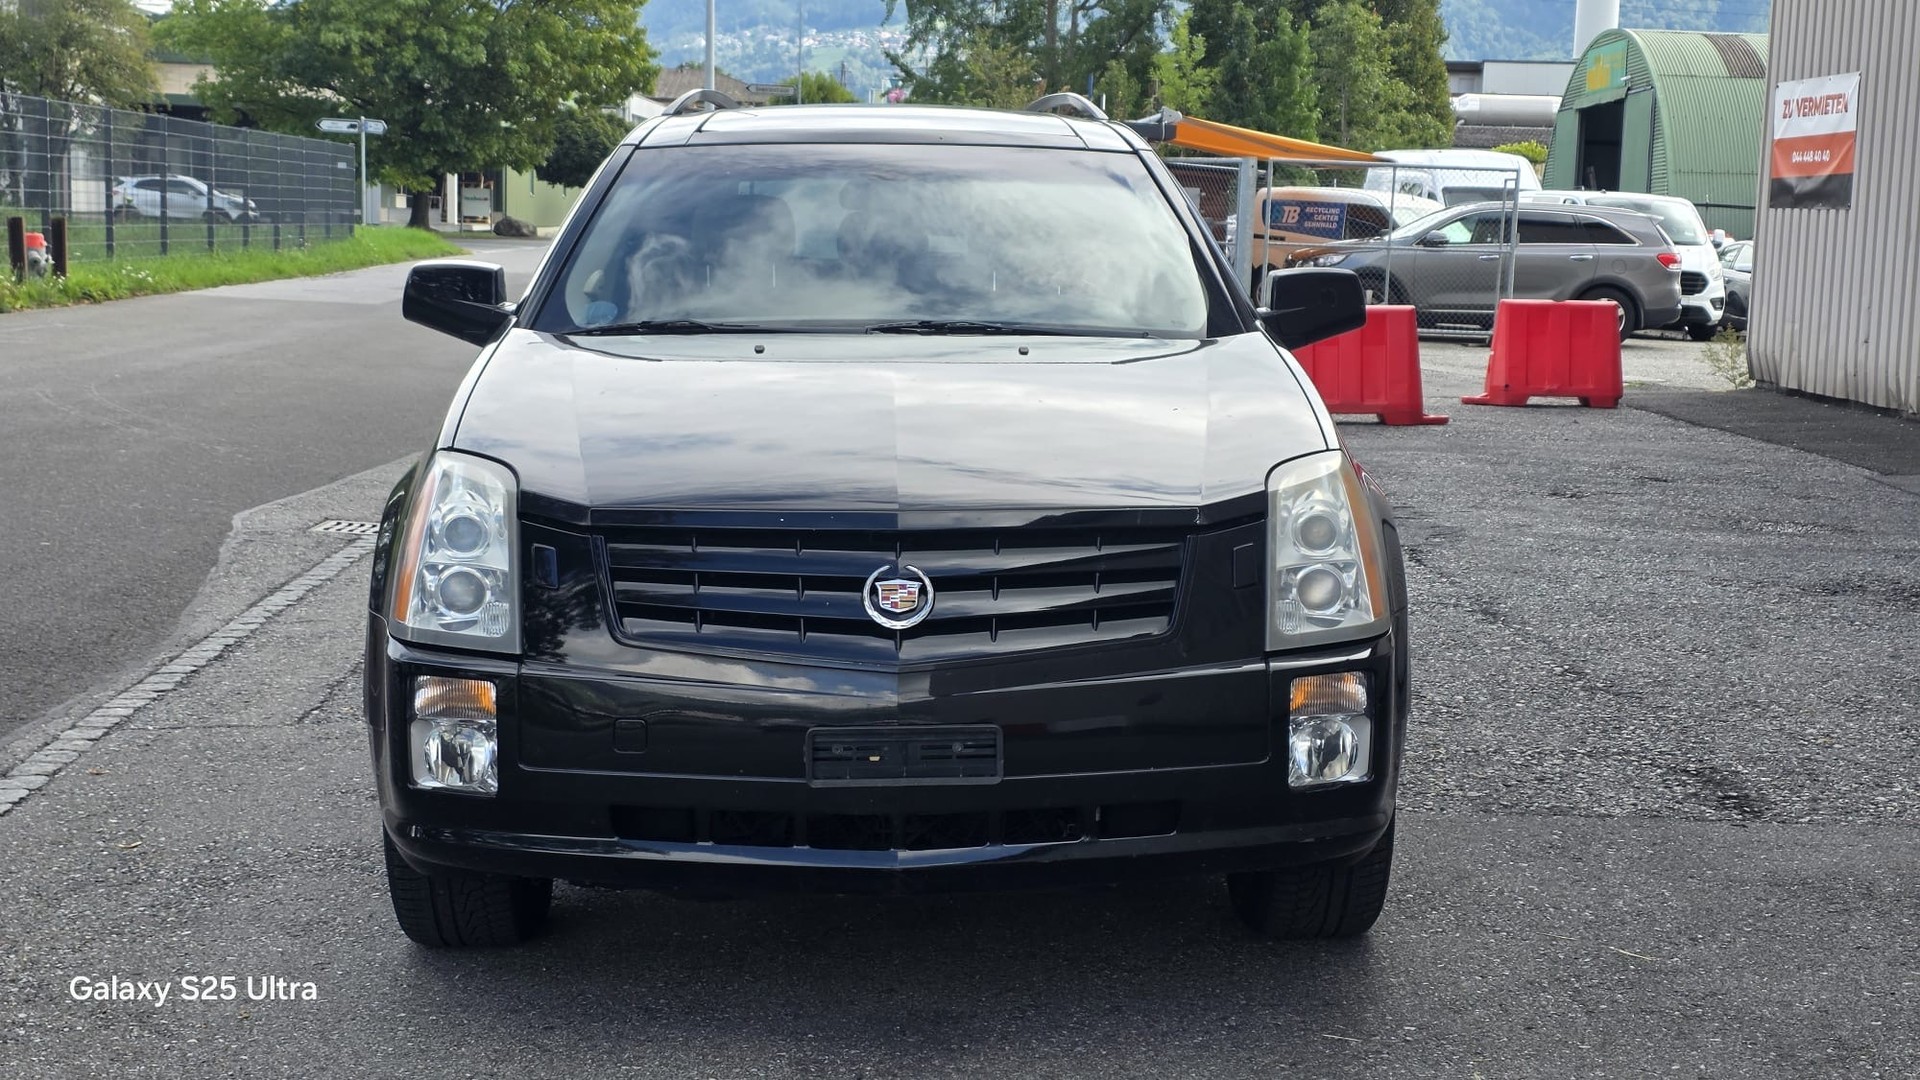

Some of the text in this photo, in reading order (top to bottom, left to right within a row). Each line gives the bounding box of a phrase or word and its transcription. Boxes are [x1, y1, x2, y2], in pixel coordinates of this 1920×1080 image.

[1782, 93, 1849, 119] ZU VERMIETEN
[1814, 150, 1822, 162] 40
[1822, 149, 1831, 162] 40
[1305, 206, 1341, 214] RECYCLING
[1313, 214, 1339, 222] CENTER
